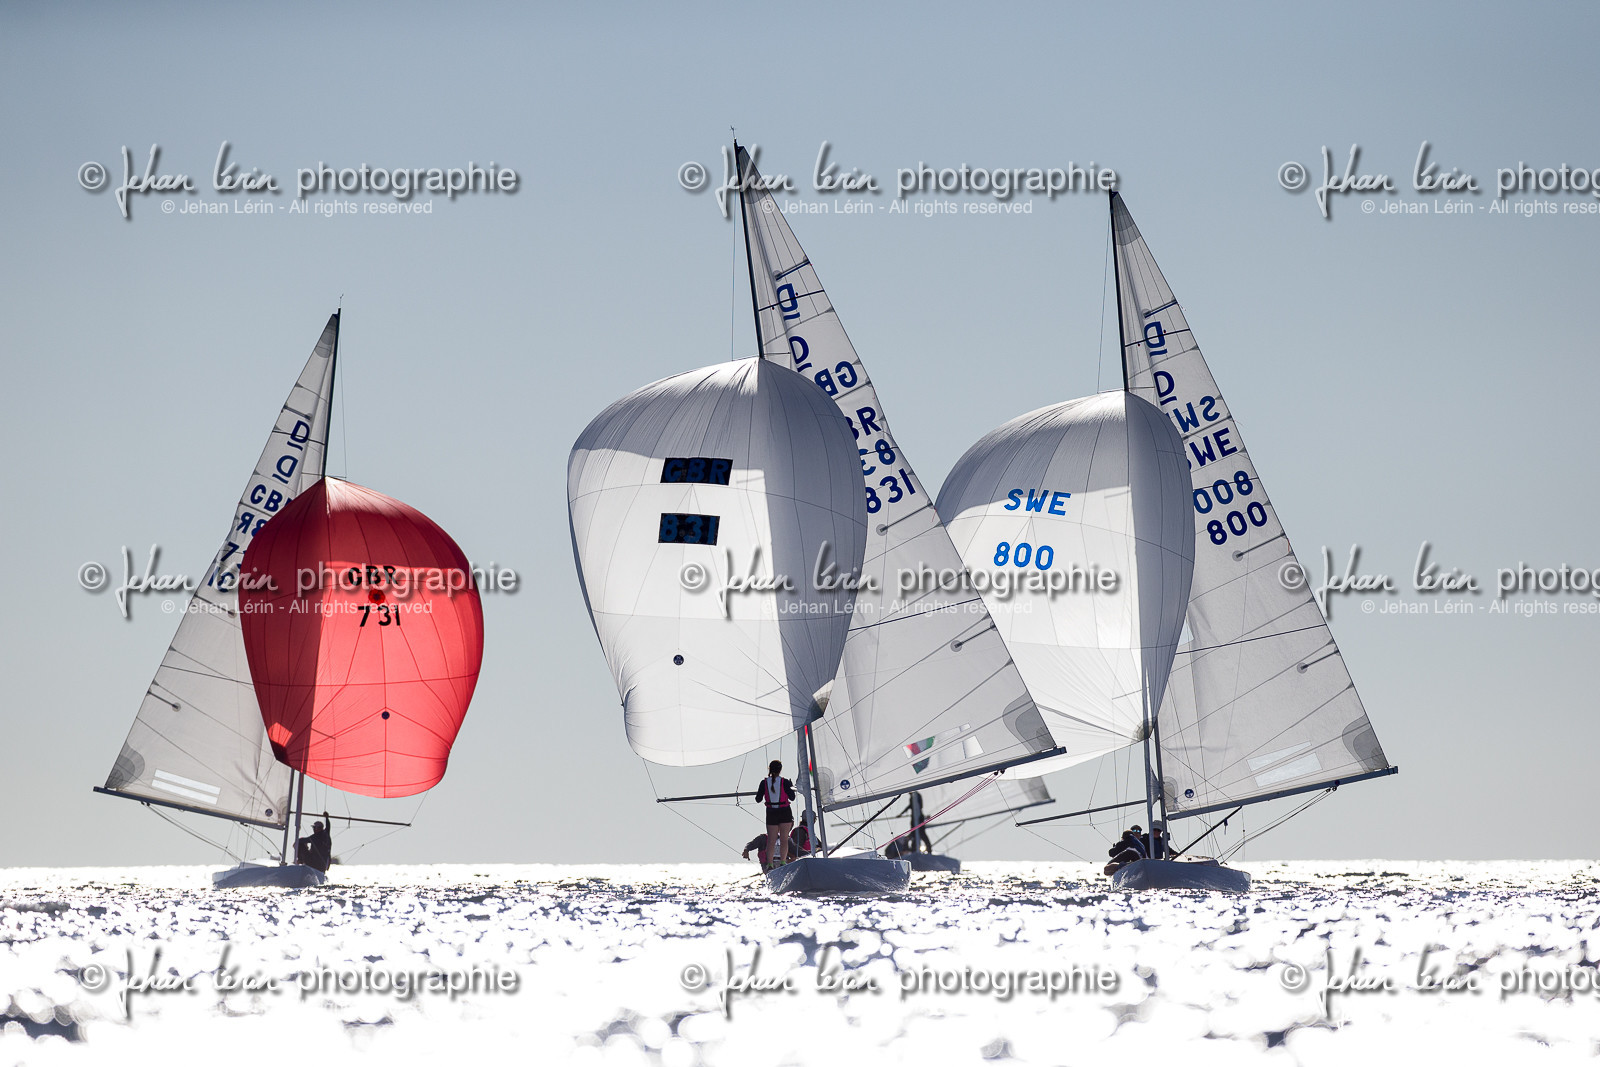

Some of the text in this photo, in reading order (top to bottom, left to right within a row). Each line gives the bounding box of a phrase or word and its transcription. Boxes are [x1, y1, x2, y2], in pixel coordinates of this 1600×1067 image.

[1188, 427, 1237, 470] WE
[664, 459, 729, 484] GBR
[250, 484, 293, 512] GB
[866, 468, 916, 514] 831
[1004, 489, 1071, 516] SWE
[660, 514, 716, 545] 831
[1206, 501, 1267, 545] 800
[993, 541, 1054, 570] 800
[348, 565, 399, 586] GBR
[358, 605, 400, 627] 731
